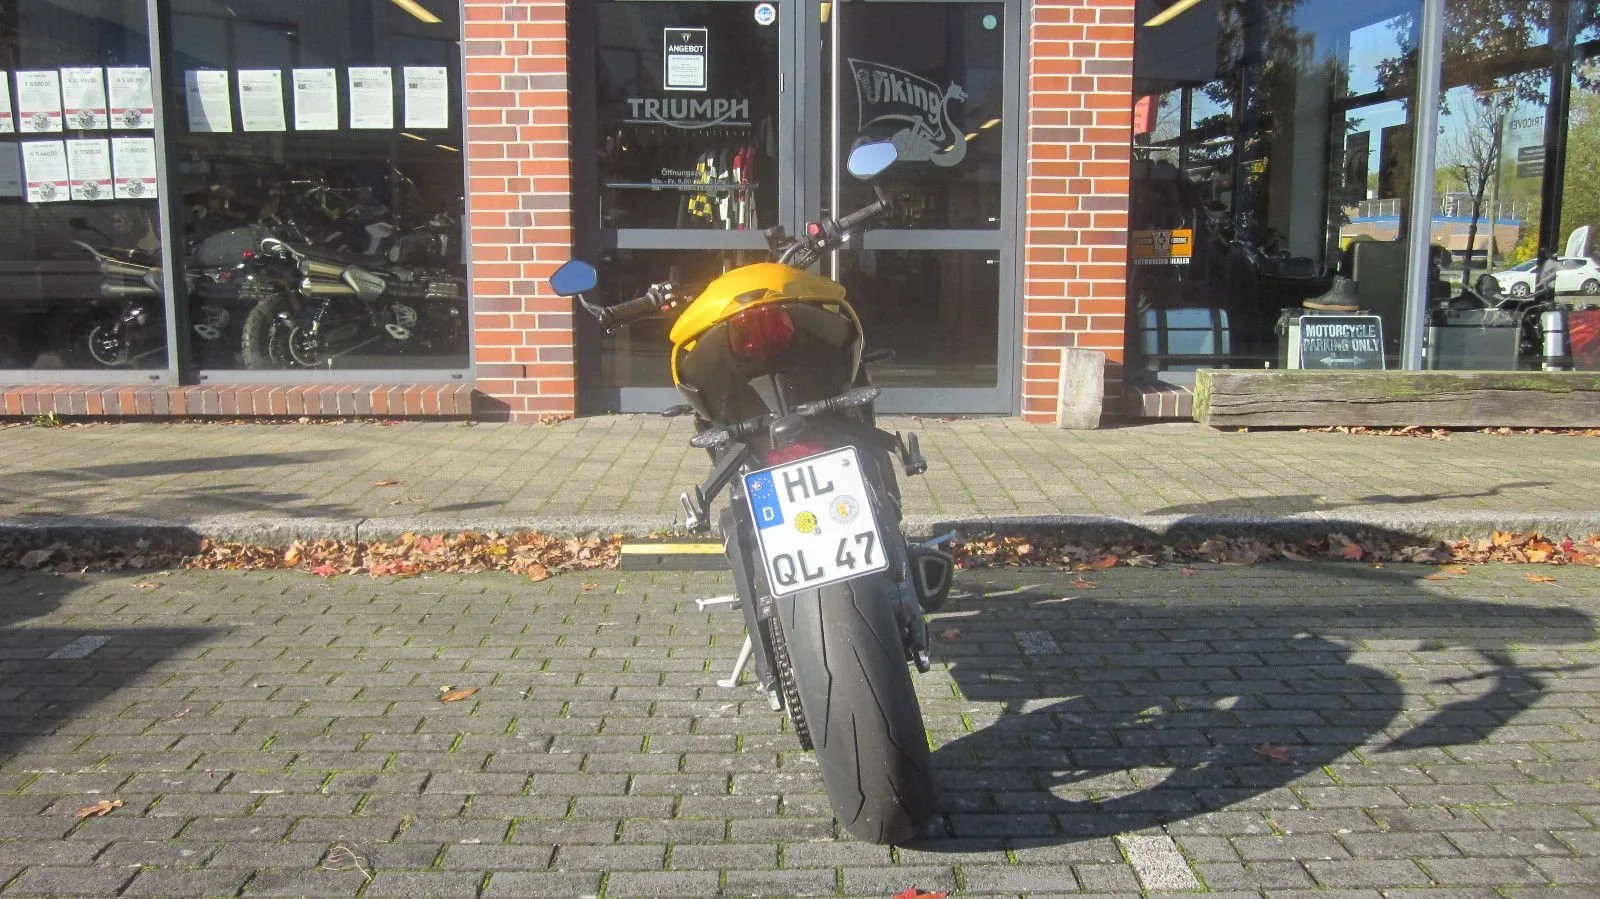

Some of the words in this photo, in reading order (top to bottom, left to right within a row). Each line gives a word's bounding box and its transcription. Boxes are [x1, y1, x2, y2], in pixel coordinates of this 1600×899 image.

[668, 45, 704, 53] ANGEBOT
[857, 69, 941, 124] Viking
[627, 98, 749, 126] TRIUMPH
[1169, 257, 1190, 265] DEALER
[1305, 324, 1376, 338] MOTORCYCLE
[1303, 338, 1349, 352] PARKING
[1351, 338, 1380, 352] ONLY
[783, 465, 834, 503] HL
[762, 506, 775, 521] D
[772, 550, 824, 586] QL
[835, 531, 875, 570] 47
